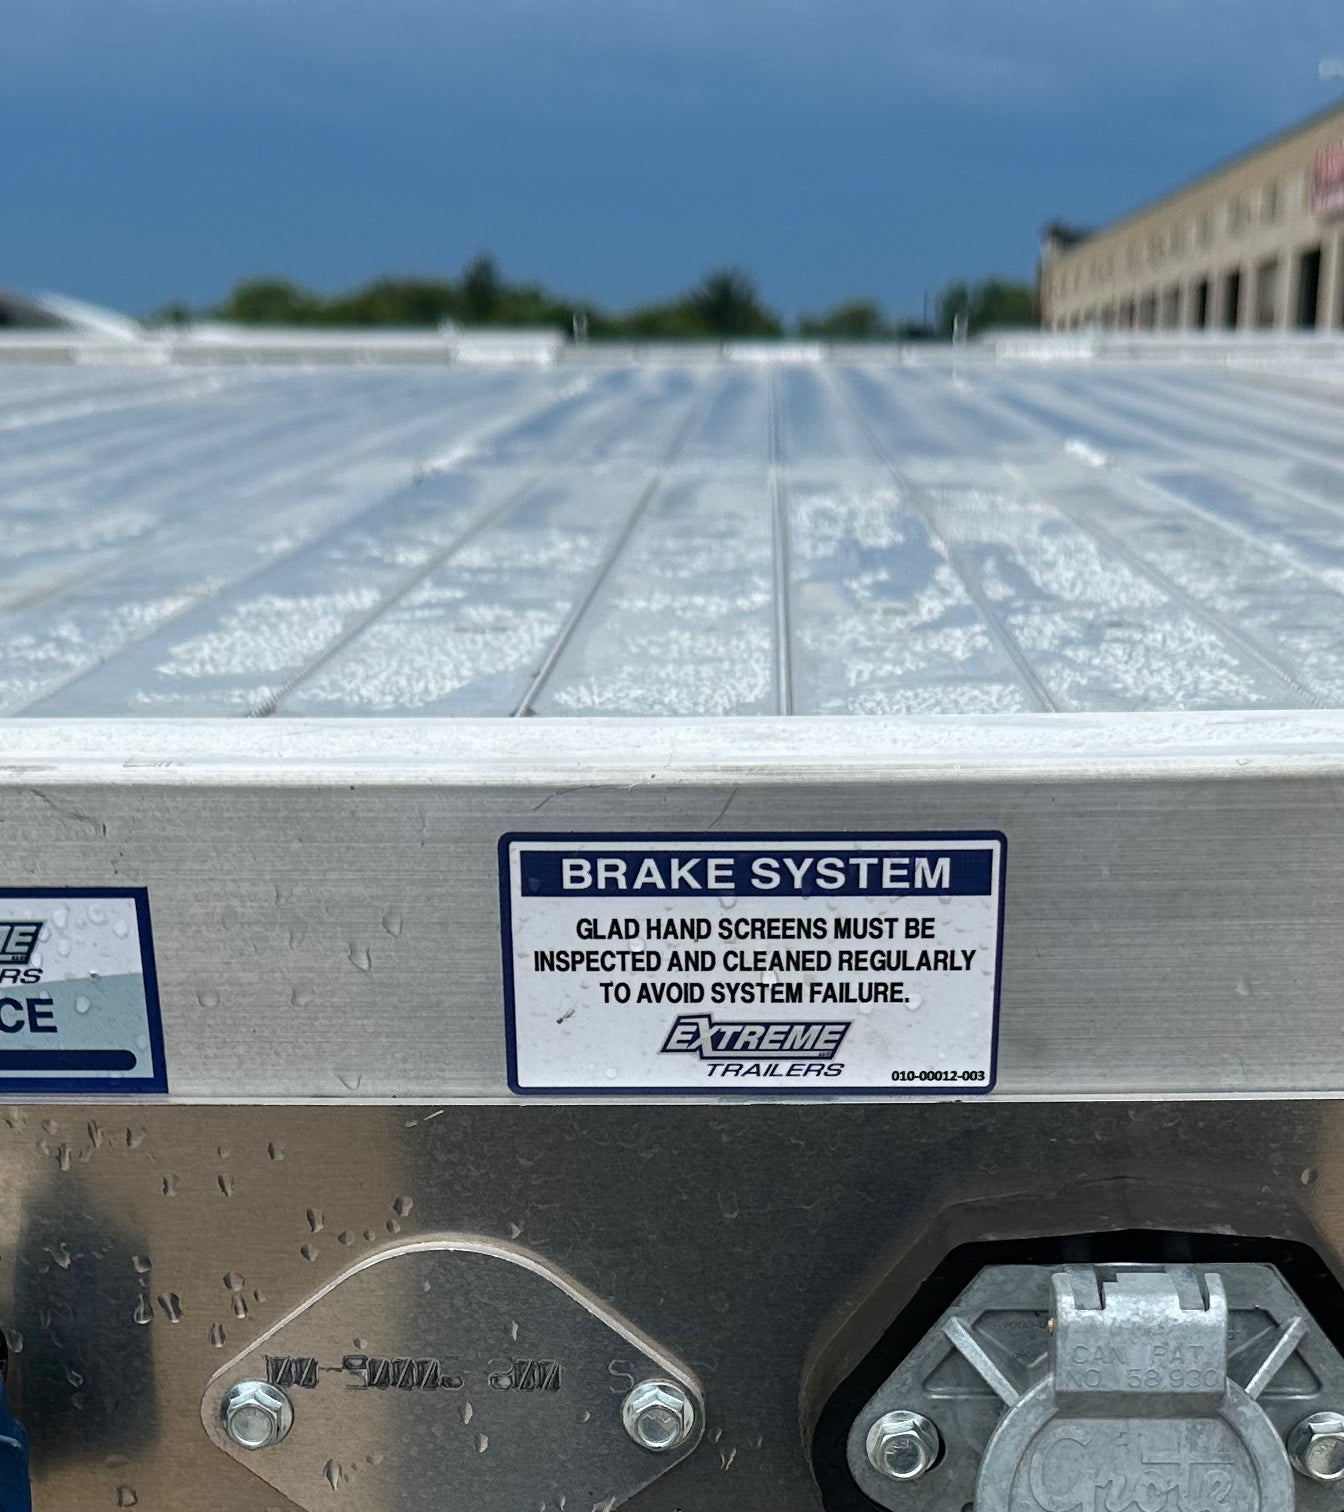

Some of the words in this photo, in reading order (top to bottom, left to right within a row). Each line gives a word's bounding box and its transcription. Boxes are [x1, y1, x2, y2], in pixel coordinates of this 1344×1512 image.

[562, 857, 736, 890] BRAKE
[750, 856, 951, 890] SYSTEM
[575, 918, 640, 940] GLAD
[646, 918, 712, 940] HAND
[717, 918, 828, 940] SCREENS
[834, 918, 899, 940] MUST
[904, 917, 936, 939] BE
[533, 951, 661, 972] INSPECTED
[667, 951, 716, 972] AND
[722, 951, 832, 972] CLEANED
[838, 950, 976, 971] REGULARLY
[599, 982, 631, 1004] TO
[636, 982, 705, 1004] AVOID
[710, 982, 803, 1004] SYSTEM
[809, 982, 910, 1003] FAILURE.
[660, 1013, 852, 1061] EXTREME
[706, 1063, 846, 1078] TRAILERS
[891, 1070, 986, 1083] 010-00012-003
